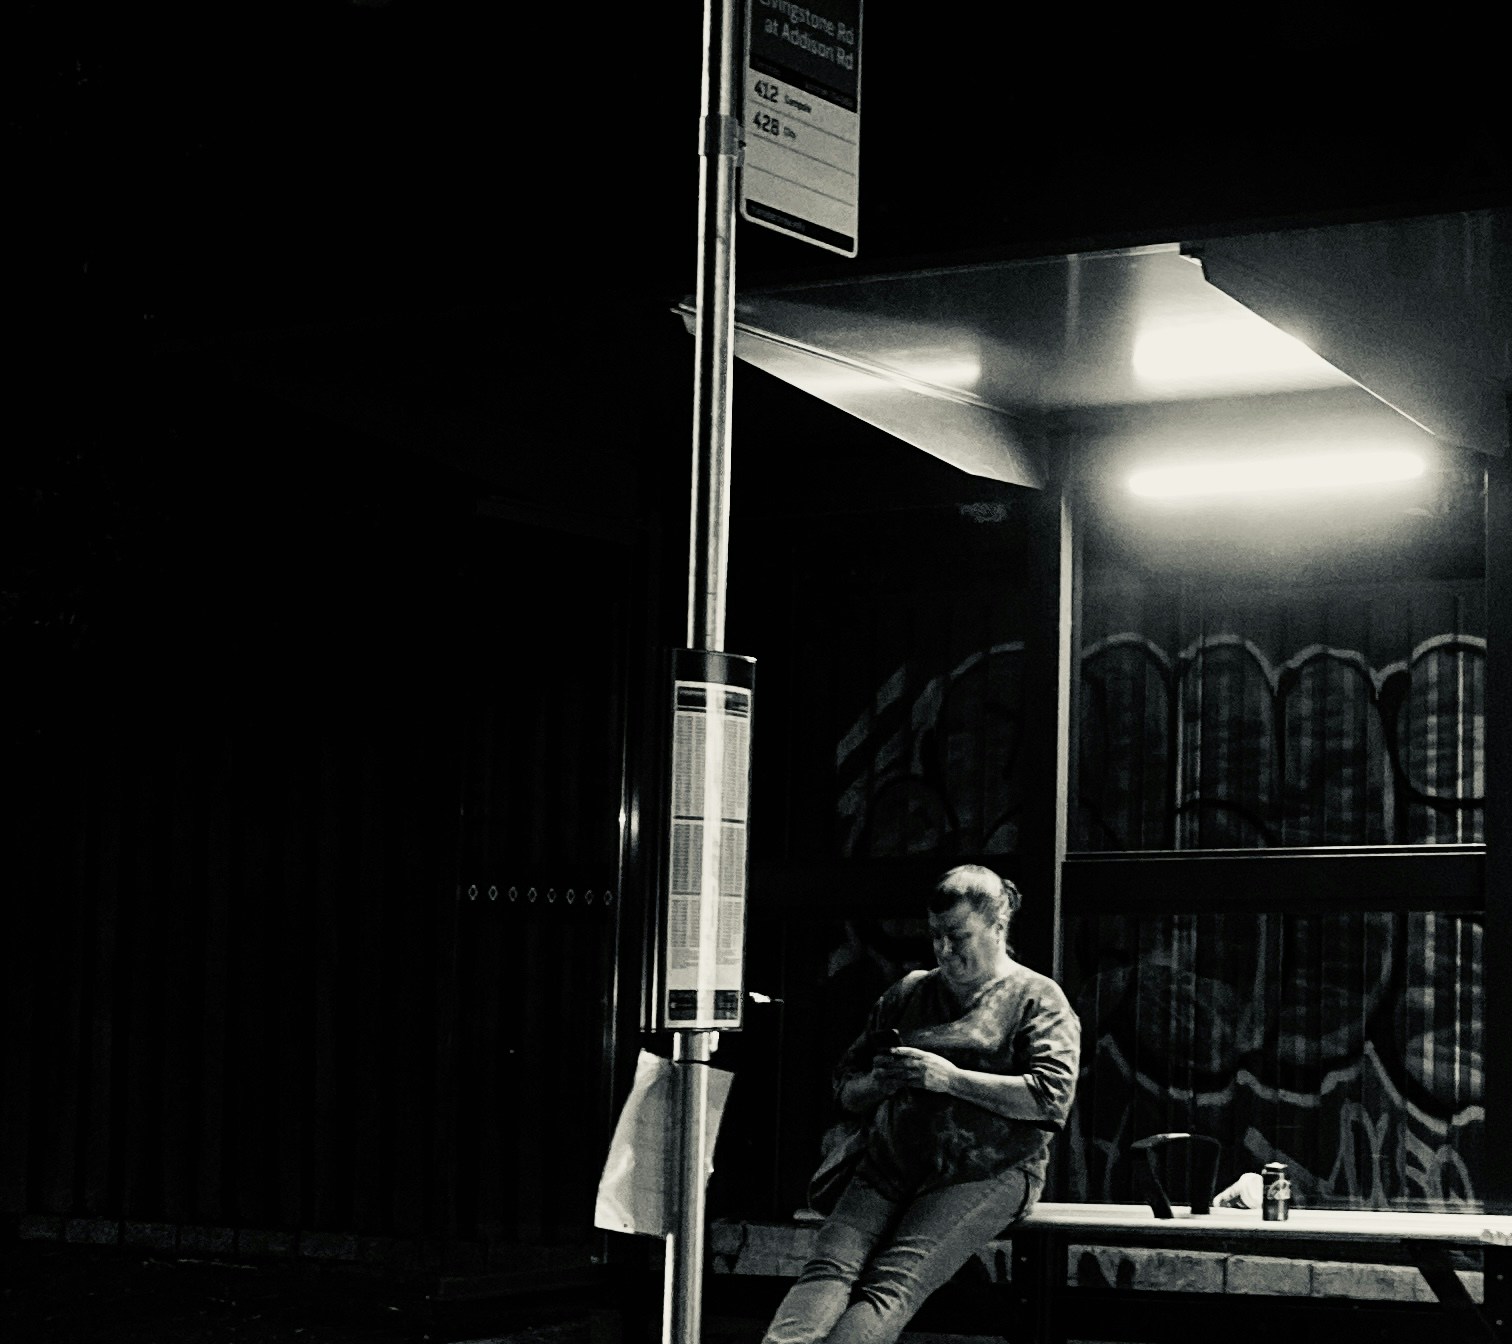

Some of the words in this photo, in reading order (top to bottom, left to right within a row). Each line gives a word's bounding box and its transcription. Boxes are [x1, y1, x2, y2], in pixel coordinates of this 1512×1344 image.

[763, 16, 779, 38] at
[781, 23, 835, 64] Addison
[835, 48, 854, 71] Rd
[836, 20, 855, 46] Rd
[753, 78, 779, 104] 412
[752, 109, 780, 137] 428
